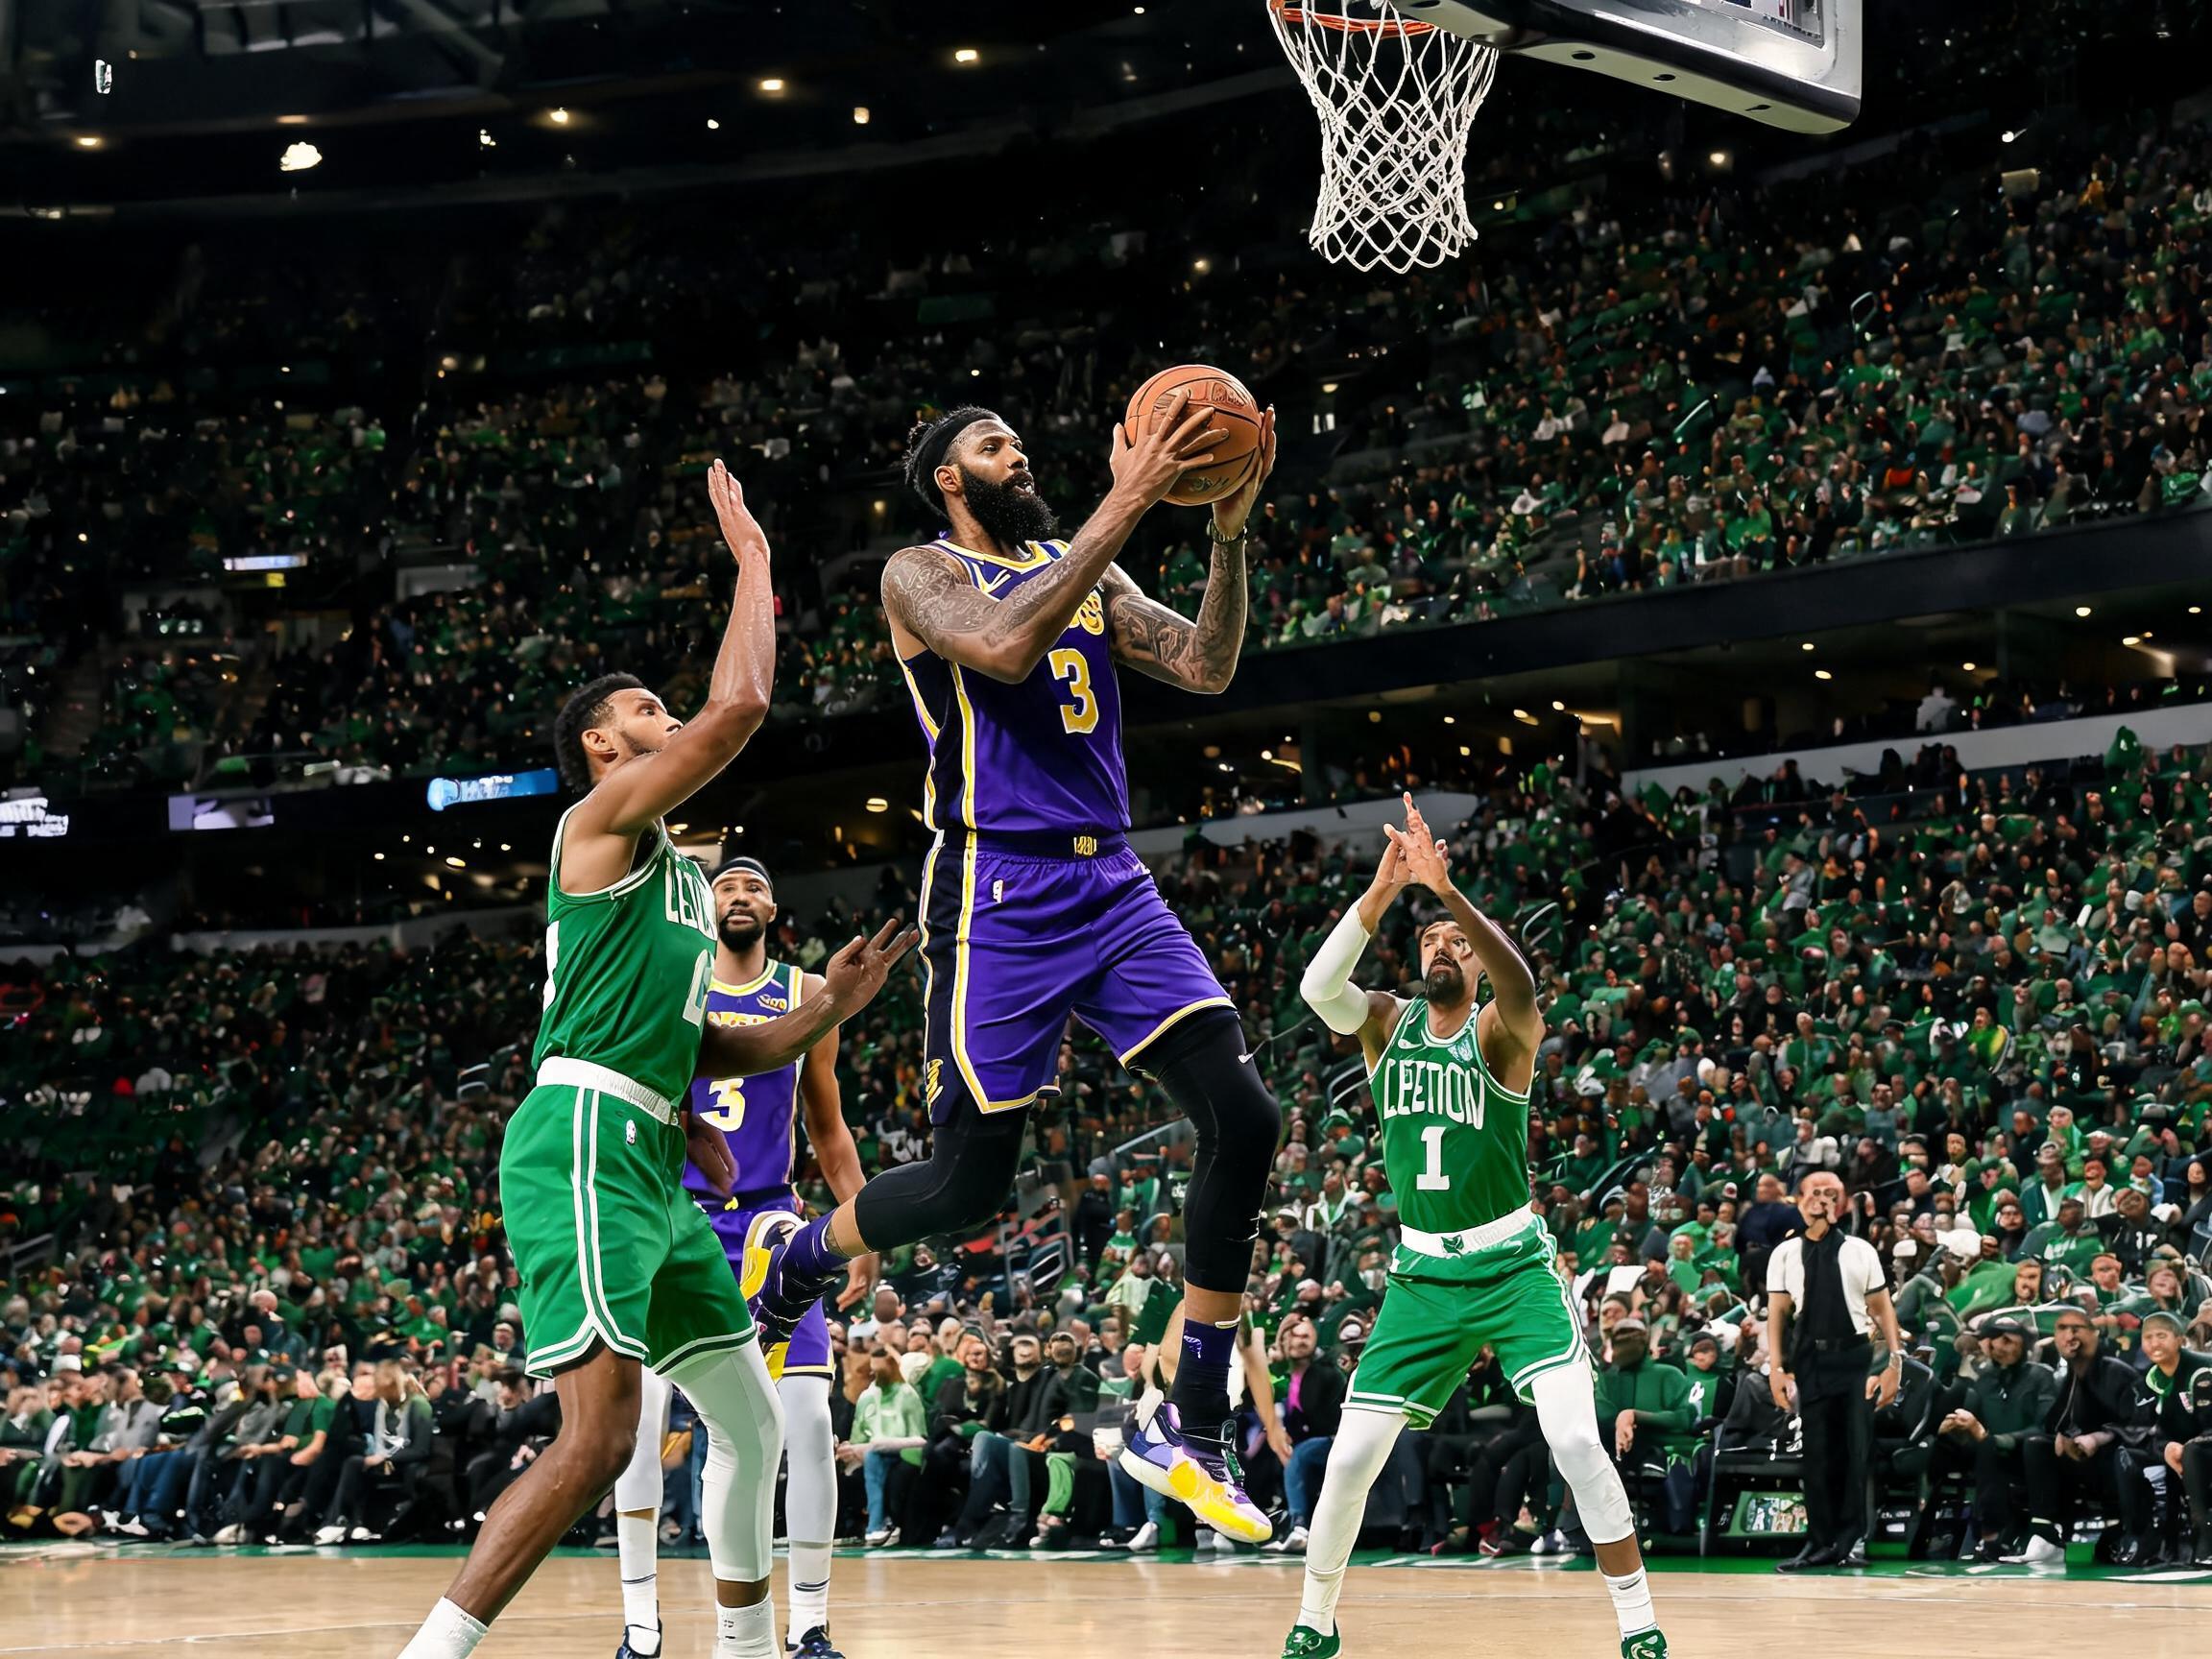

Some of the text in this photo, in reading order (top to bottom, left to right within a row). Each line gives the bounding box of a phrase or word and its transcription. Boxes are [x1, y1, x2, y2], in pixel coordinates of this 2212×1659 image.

[1047, 647, 1099, 734] 3
[699, 1077, 746, 1133] 3
[1416, 1126, 1451, 1190] 1
